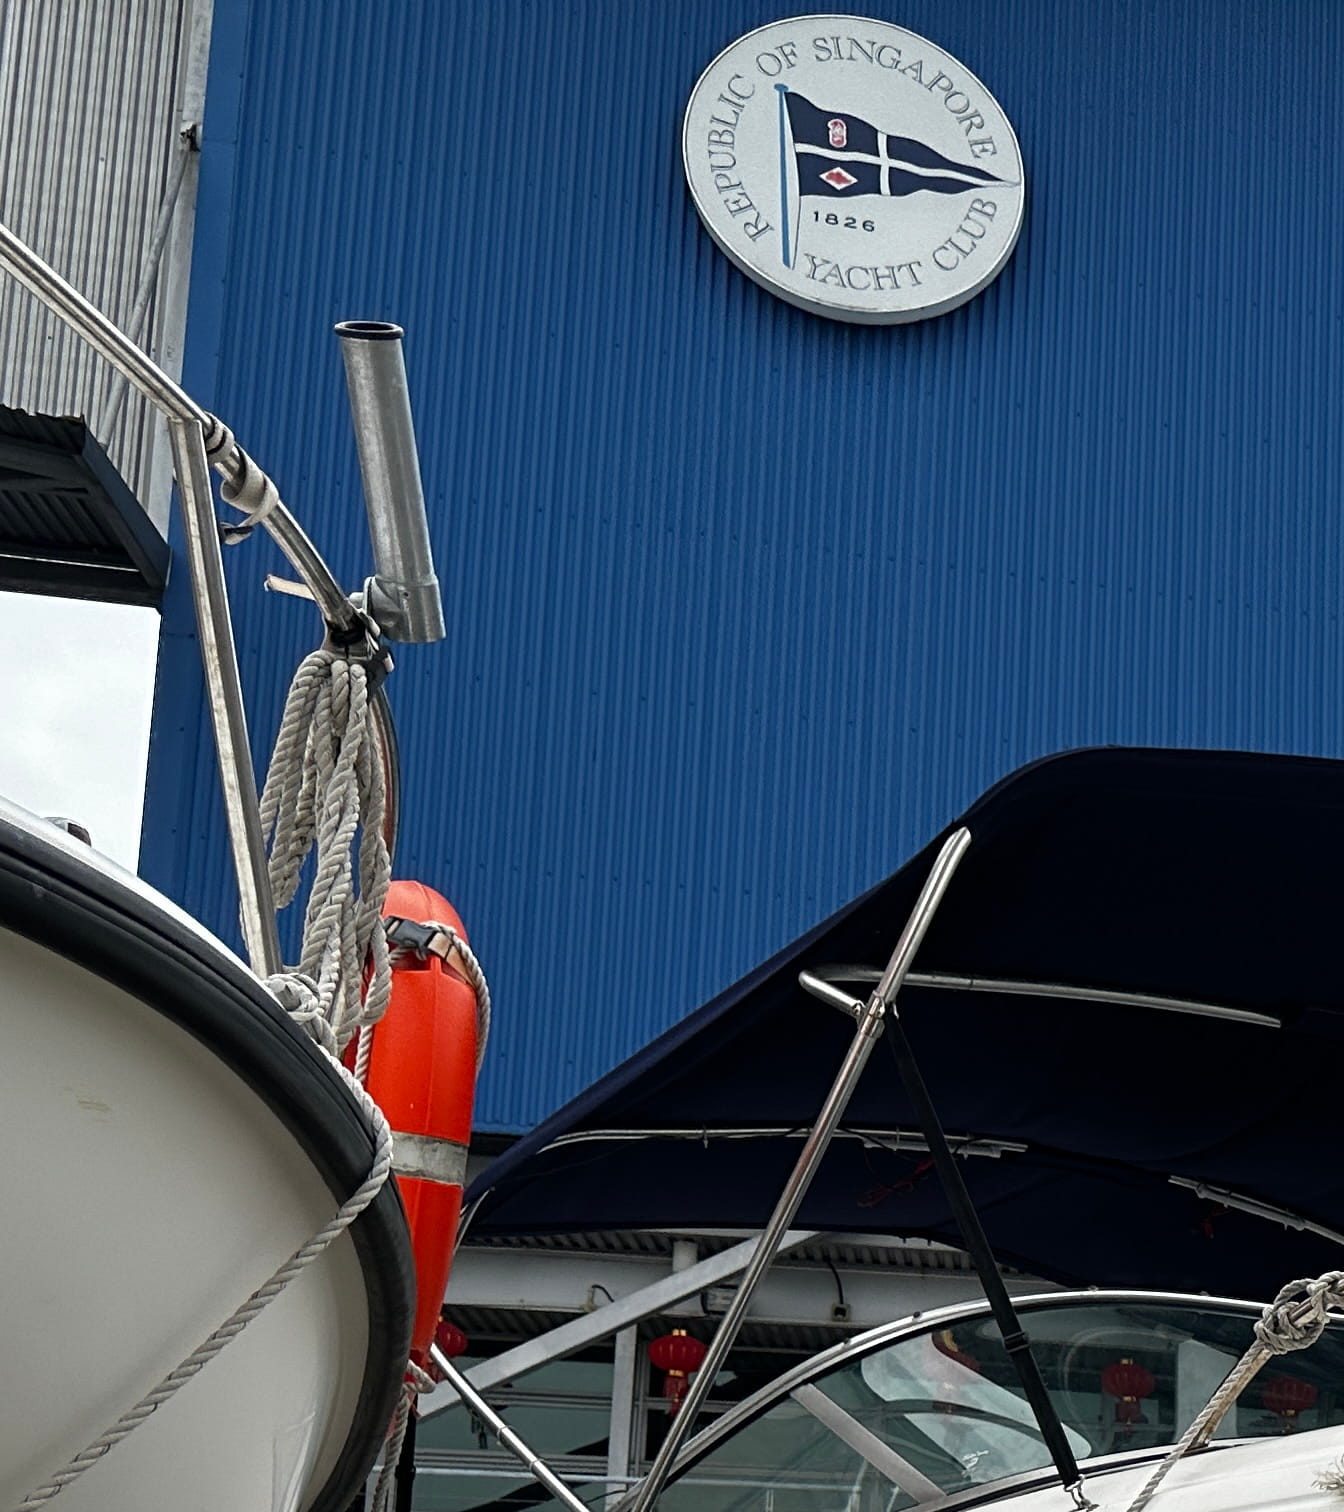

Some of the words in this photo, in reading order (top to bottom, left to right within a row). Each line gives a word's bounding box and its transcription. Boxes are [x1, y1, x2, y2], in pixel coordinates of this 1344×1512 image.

[708, 74, 774, 243] REPUBLIC
[755, 42, 798, 76] OF
[812, 36, 998, 159] SINGAPORE
[804, 252, 922, 291] YACHT
[932, 197, 998, 272] CLUB
[813, 210, 876, 233] 1826
